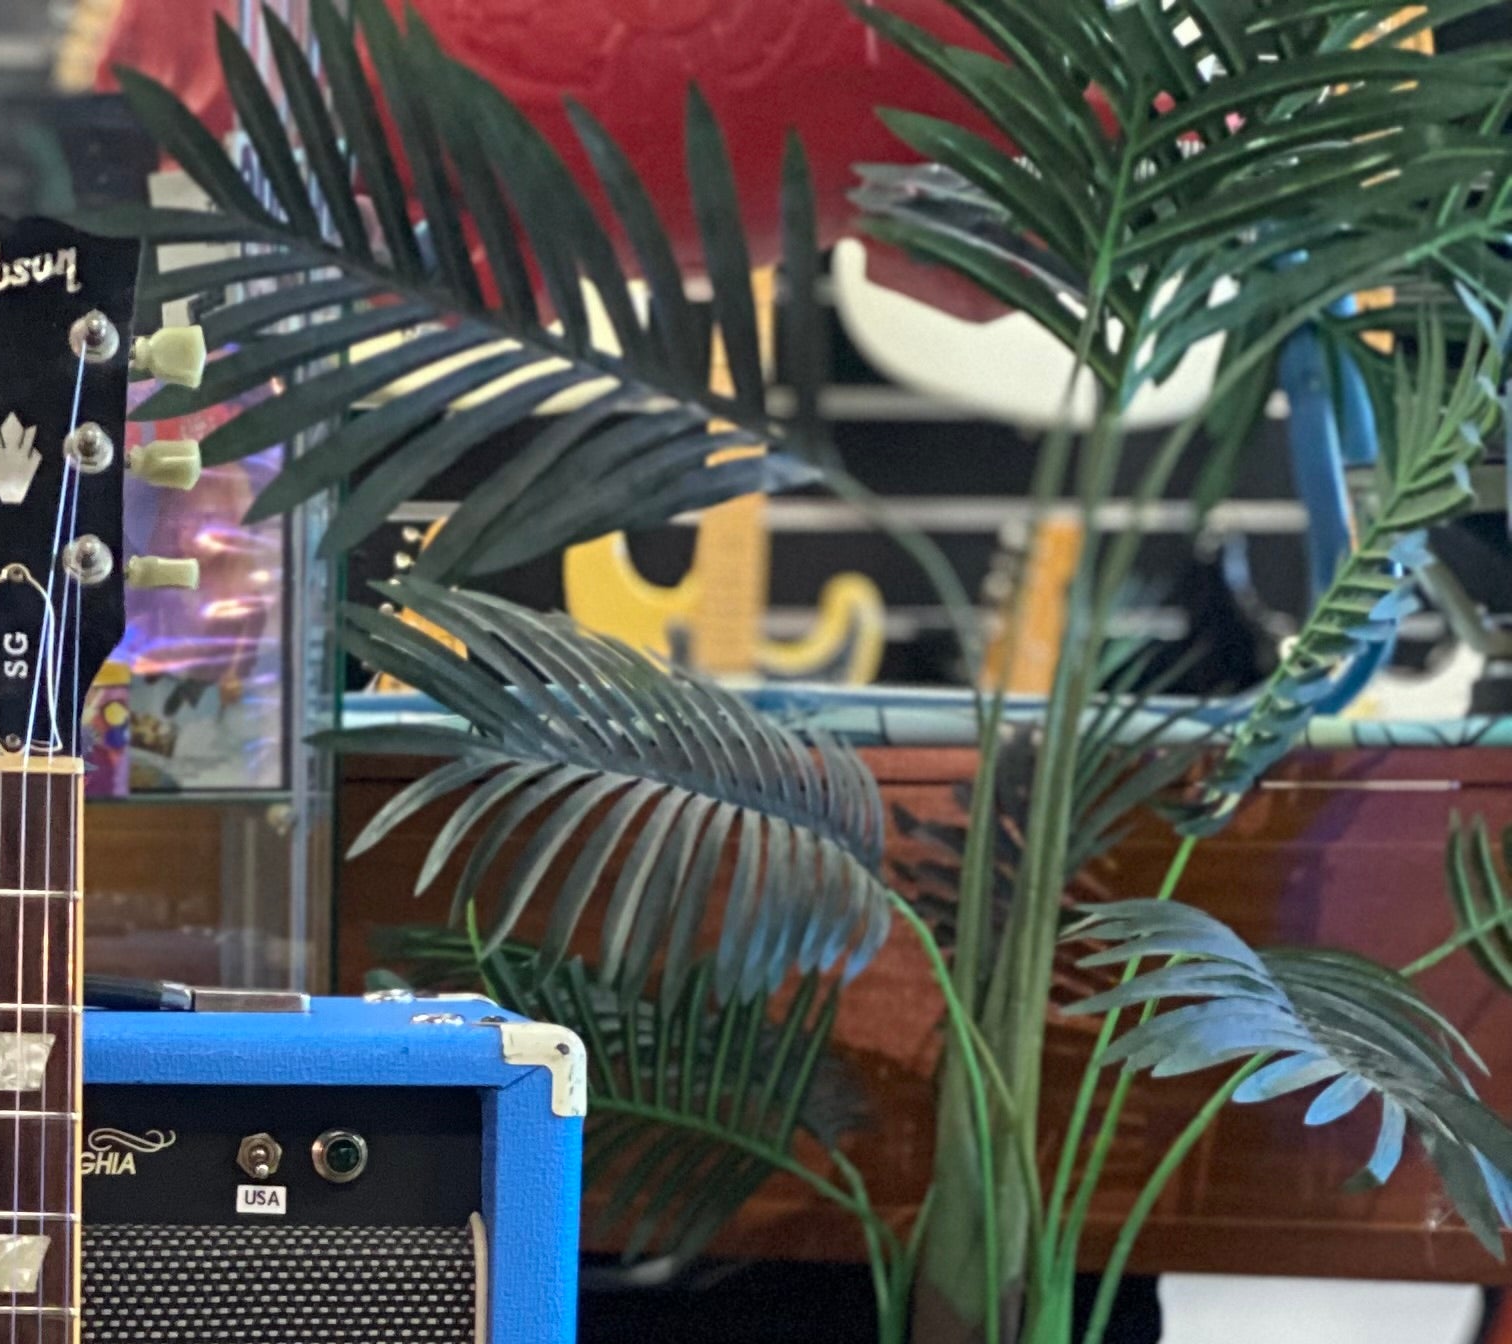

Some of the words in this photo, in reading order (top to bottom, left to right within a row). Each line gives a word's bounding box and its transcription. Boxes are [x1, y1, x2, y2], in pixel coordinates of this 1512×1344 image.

[2, 631, 29, 680] SG
[81, 1151, 137, 1176] GHIA
[244, 1189, 280, 1207] USA
